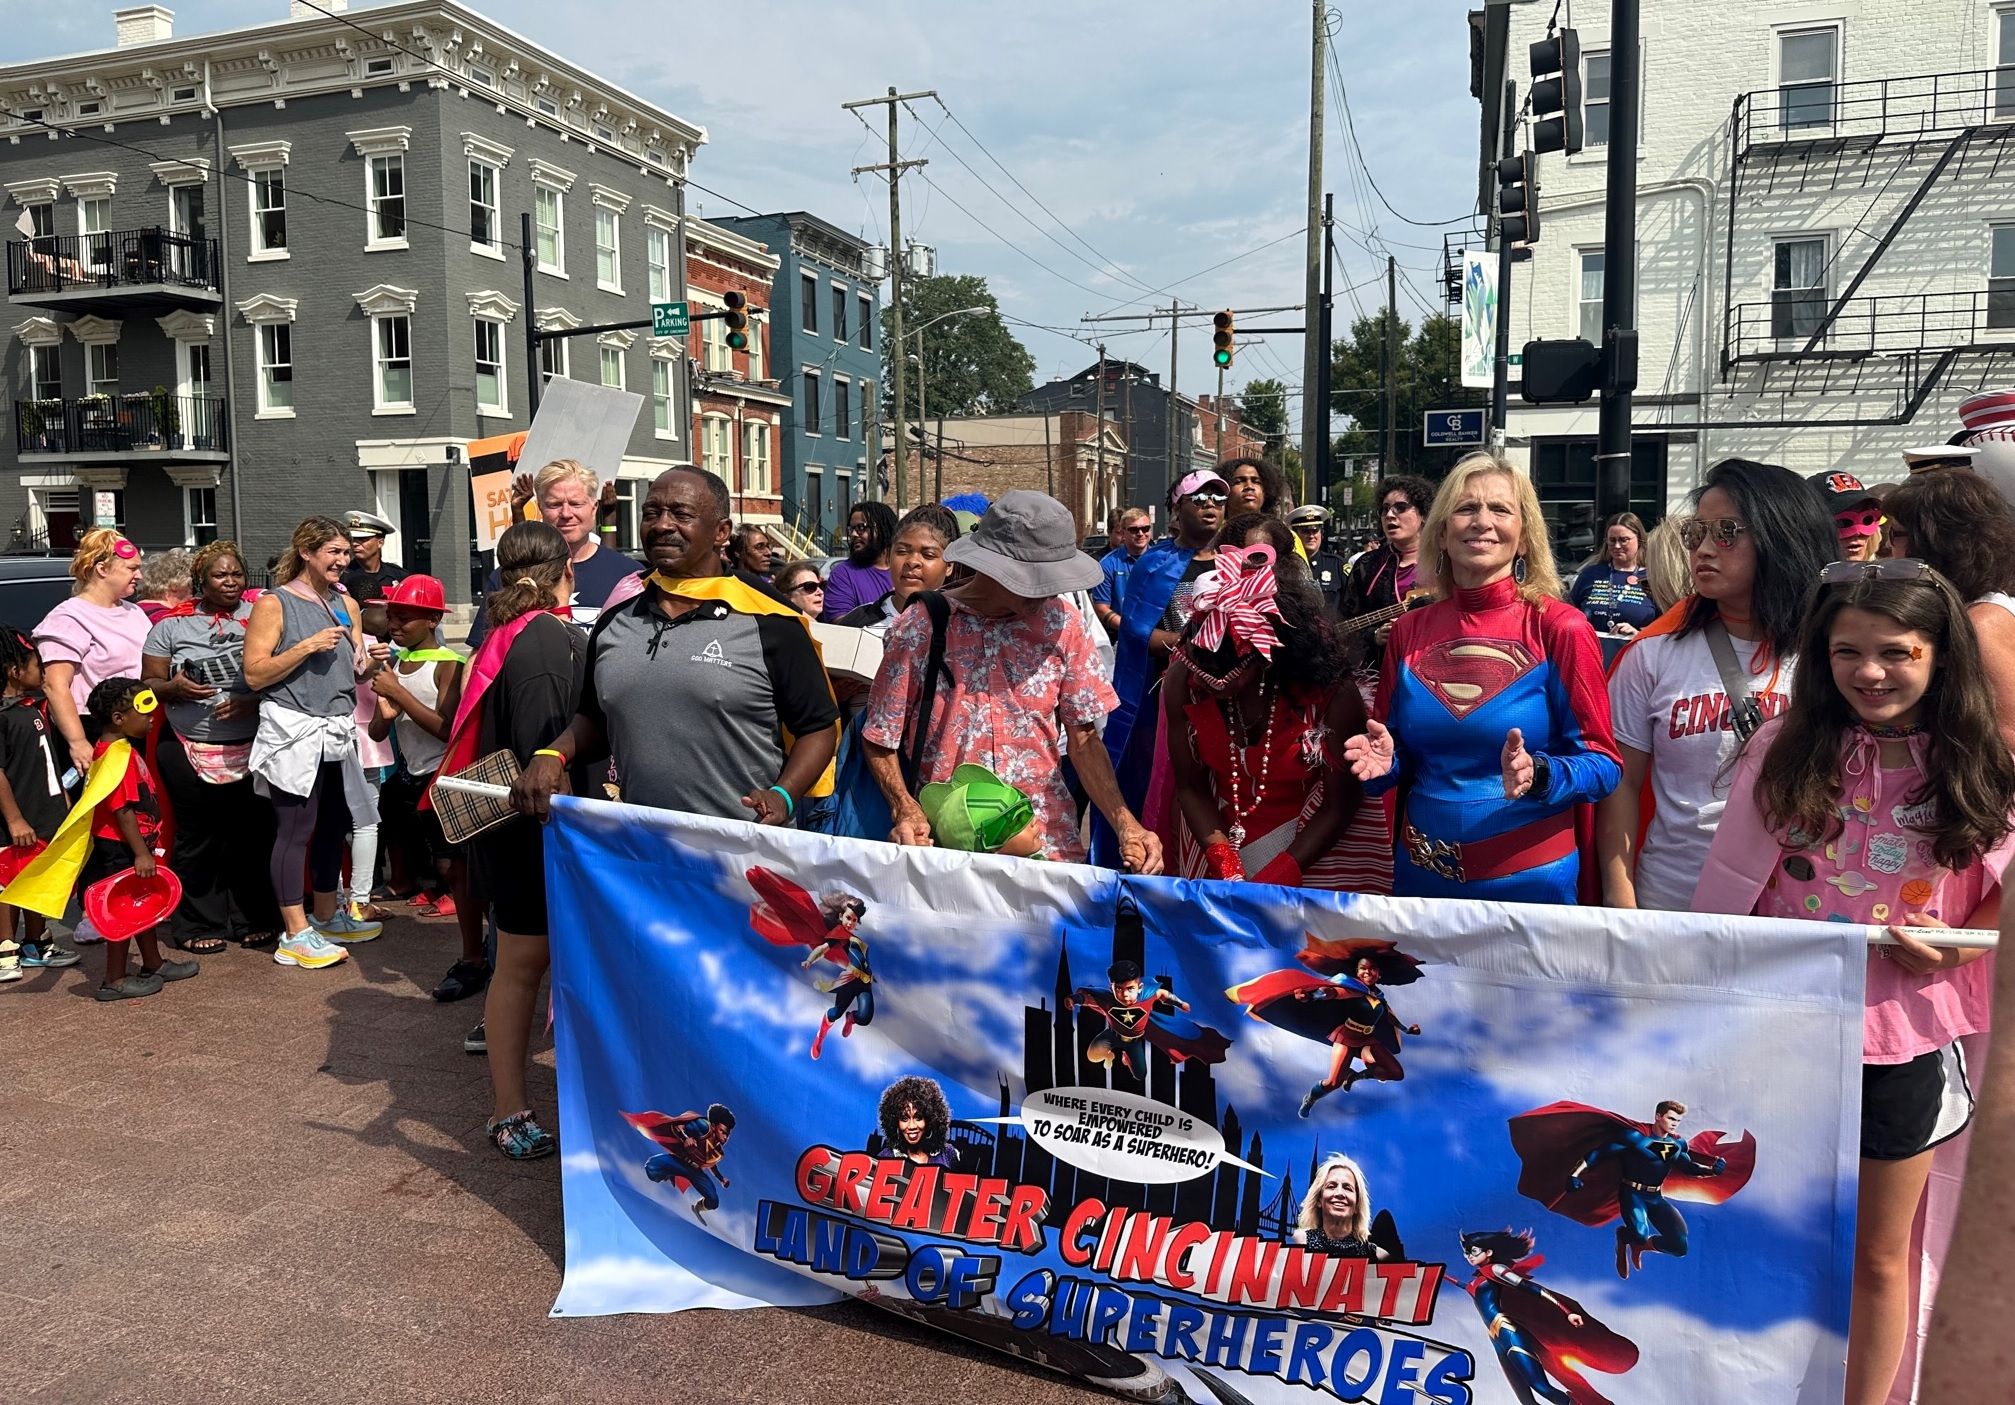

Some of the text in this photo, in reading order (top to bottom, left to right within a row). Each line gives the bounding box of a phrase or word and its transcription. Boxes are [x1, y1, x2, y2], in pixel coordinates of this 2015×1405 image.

[654, 308, 687, 328] PARKING
[704, 657, 732, 667] MATTERS
[1043, 1092, 1193, 1132] WHERE EVERY CHILD IS
[1078, 1112, 1163, 1140] EMPOWERED
[1033, 1119, 1215, 1171] TO SOAR AS A SUPERHERO!
[796, 1145, 1446, 1326] GREATER CINCINNATI
[755, 1199, 1475, 1405] LAND OF SUPERHEROES
